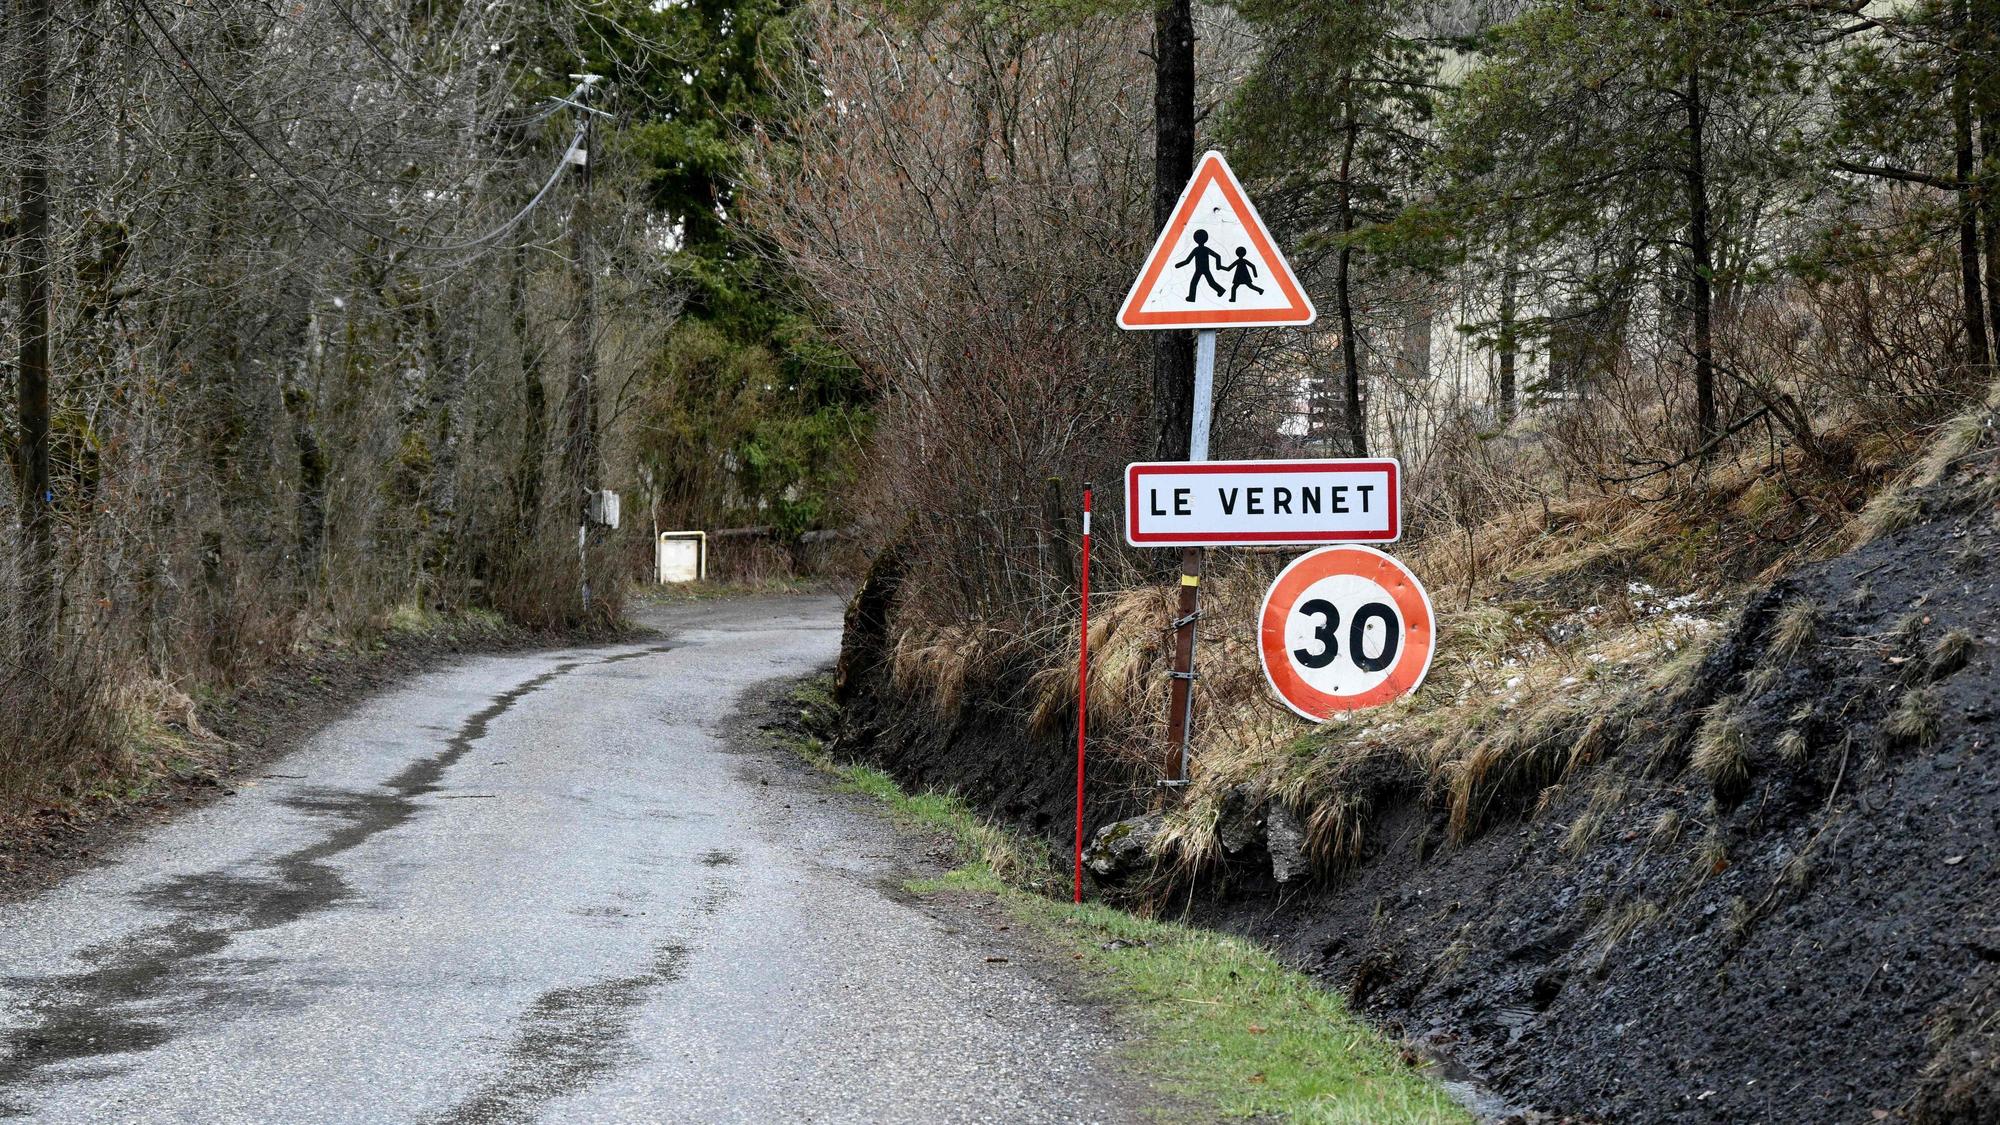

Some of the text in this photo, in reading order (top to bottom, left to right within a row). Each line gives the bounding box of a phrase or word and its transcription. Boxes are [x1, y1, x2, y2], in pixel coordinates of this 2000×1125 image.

[1150, 485, 1375, 516] LE VERNET
[1293, 598, 1400, 673] 30
